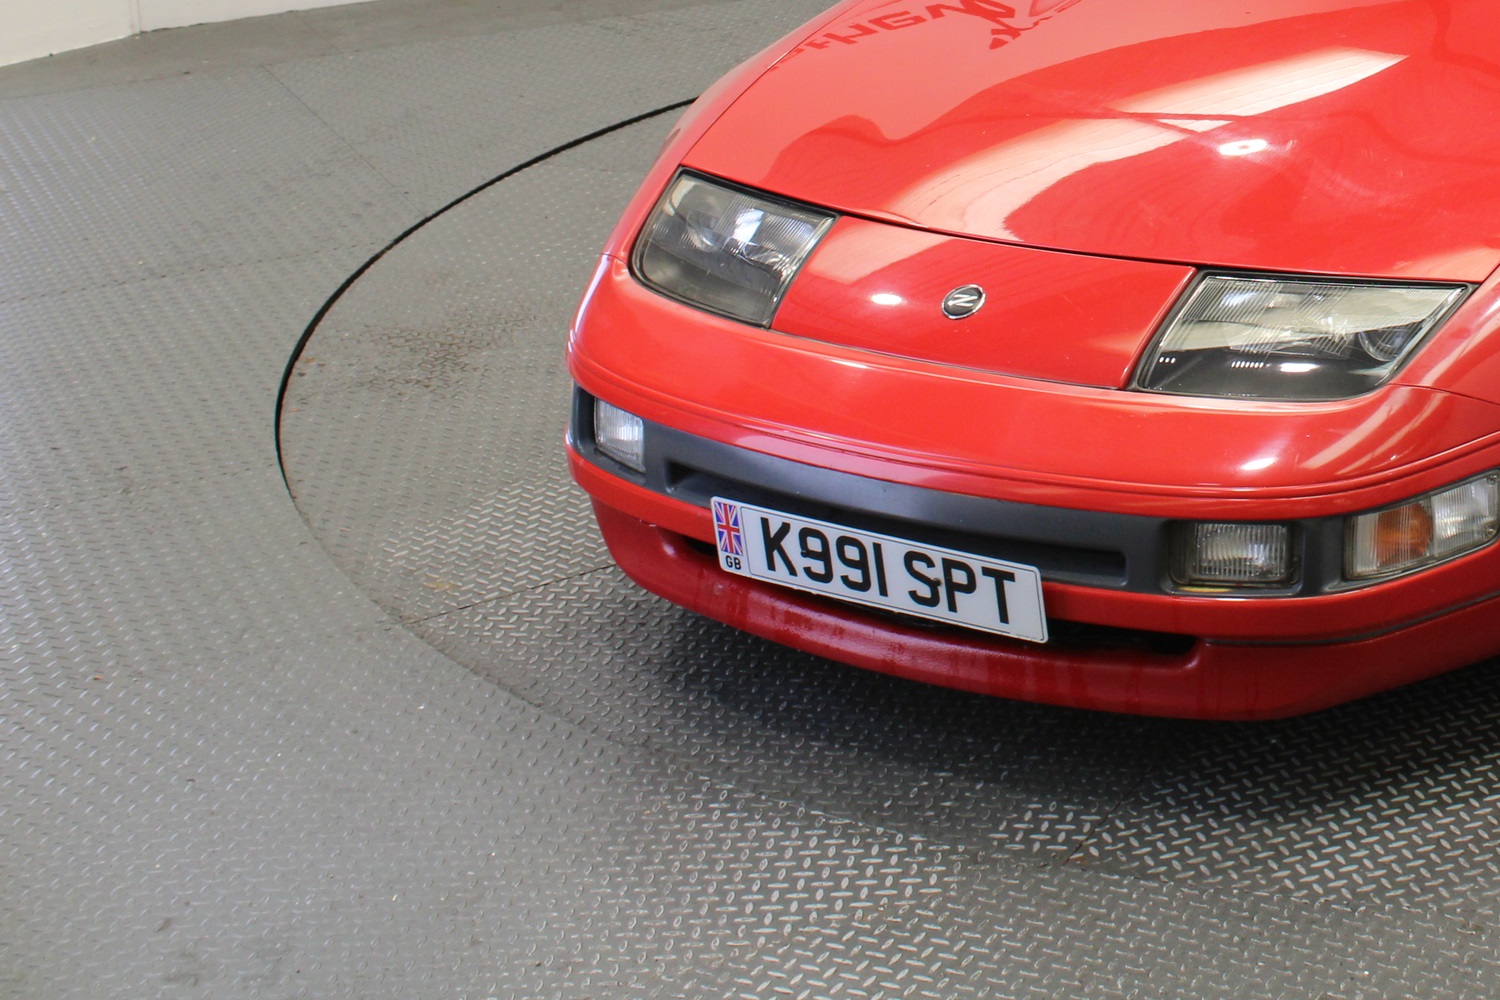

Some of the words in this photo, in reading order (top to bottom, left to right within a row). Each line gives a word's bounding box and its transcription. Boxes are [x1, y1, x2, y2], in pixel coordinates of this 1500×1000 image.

[725, 555, 741, 570] GB
[760, 517, 888, 597] K991
[903, 550, 1015, 624] SPT
